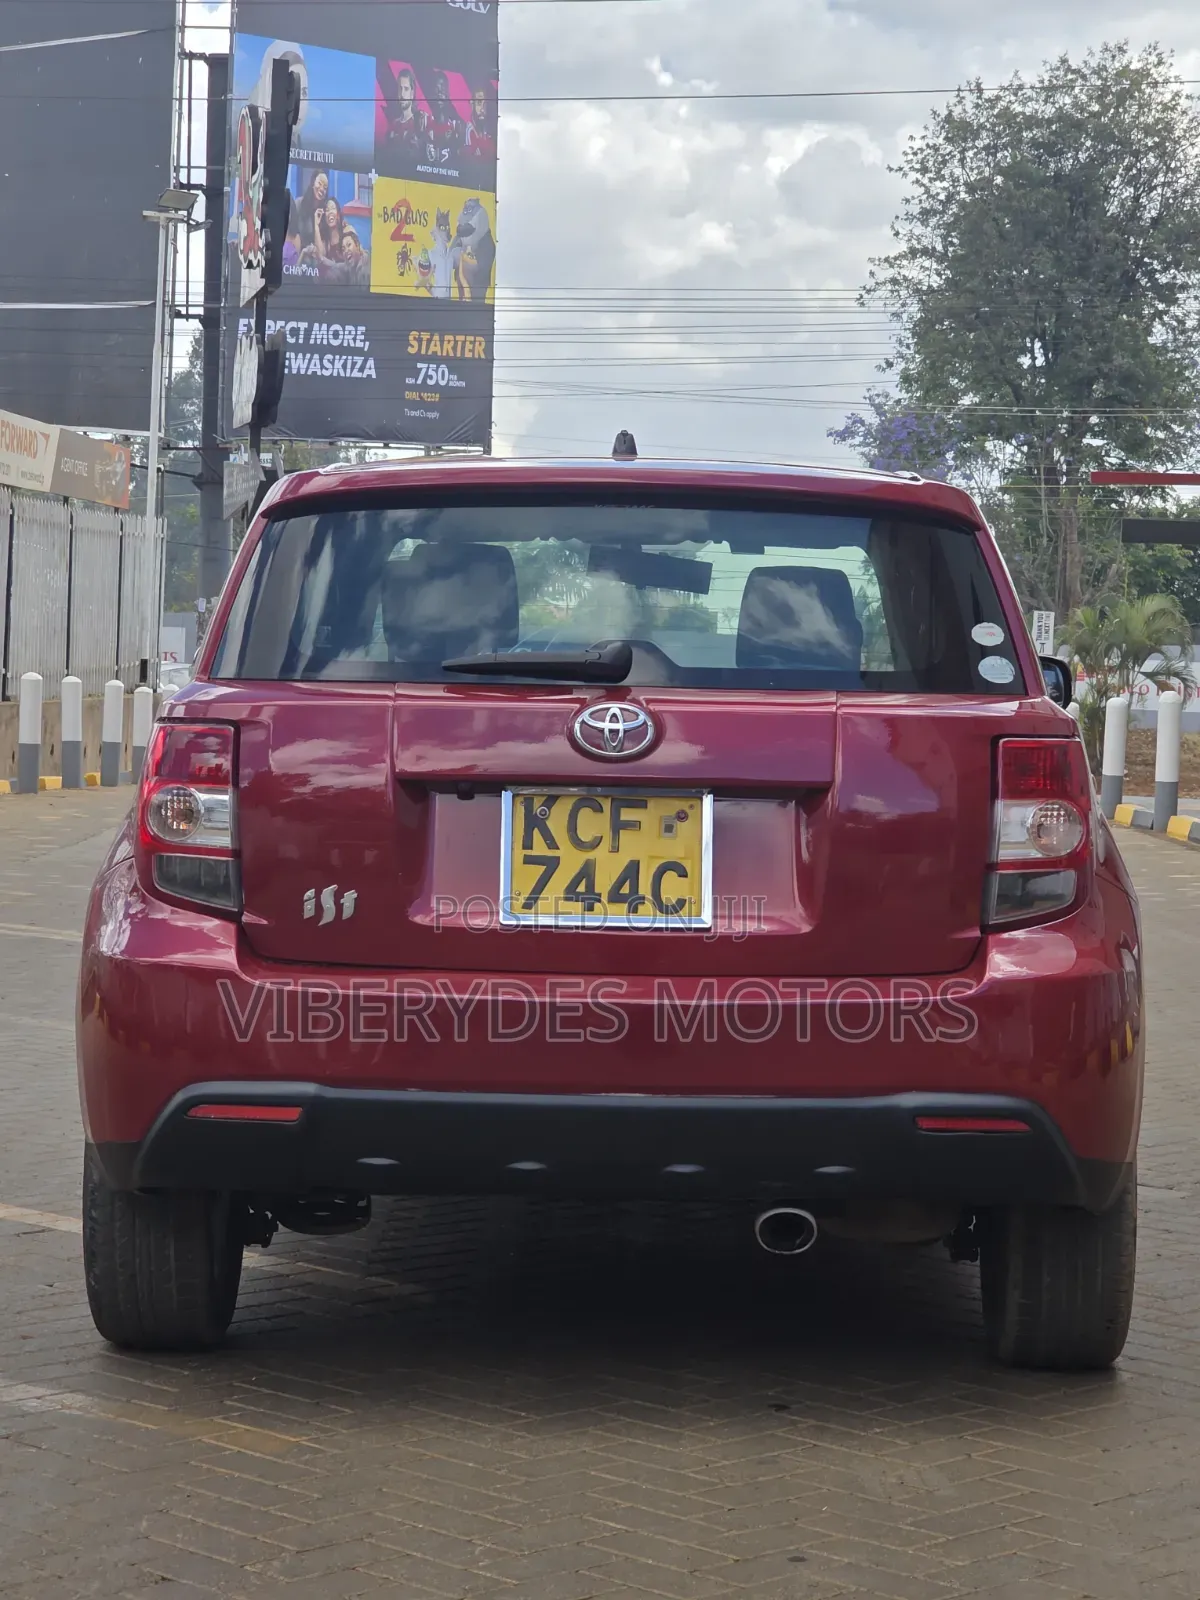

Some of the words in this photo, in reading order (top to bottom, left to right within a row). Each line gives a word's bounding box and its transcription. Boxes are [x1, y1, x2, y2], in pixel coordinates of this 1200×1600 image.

[314, 151, 334, 164] TRUTH
[416, 165, 432, 173] MATCH
[448, 169, 460, 177] WEEK
[383, 206, 402, 223] BAD
[405, 208, 428, 228] GUYS
[390, 198, 415, 242] 2
[309, 322, 370, 352] MORE,
[407, 331, 486, 359] STARTER
[416, 362, 449, 386] 750
[449, 380, 466, 388] MONTH
[405, 391, 420, 401] DIAL
[410, 409, 420, 417] and
[426, 410, 440, 420] apply
[0, 419, 38, 460] FORWARD
[1035, 624, 1043, 642] THANK
[521, 796, 648, 853] KCF
[519, 853, 690, 915] 744C
